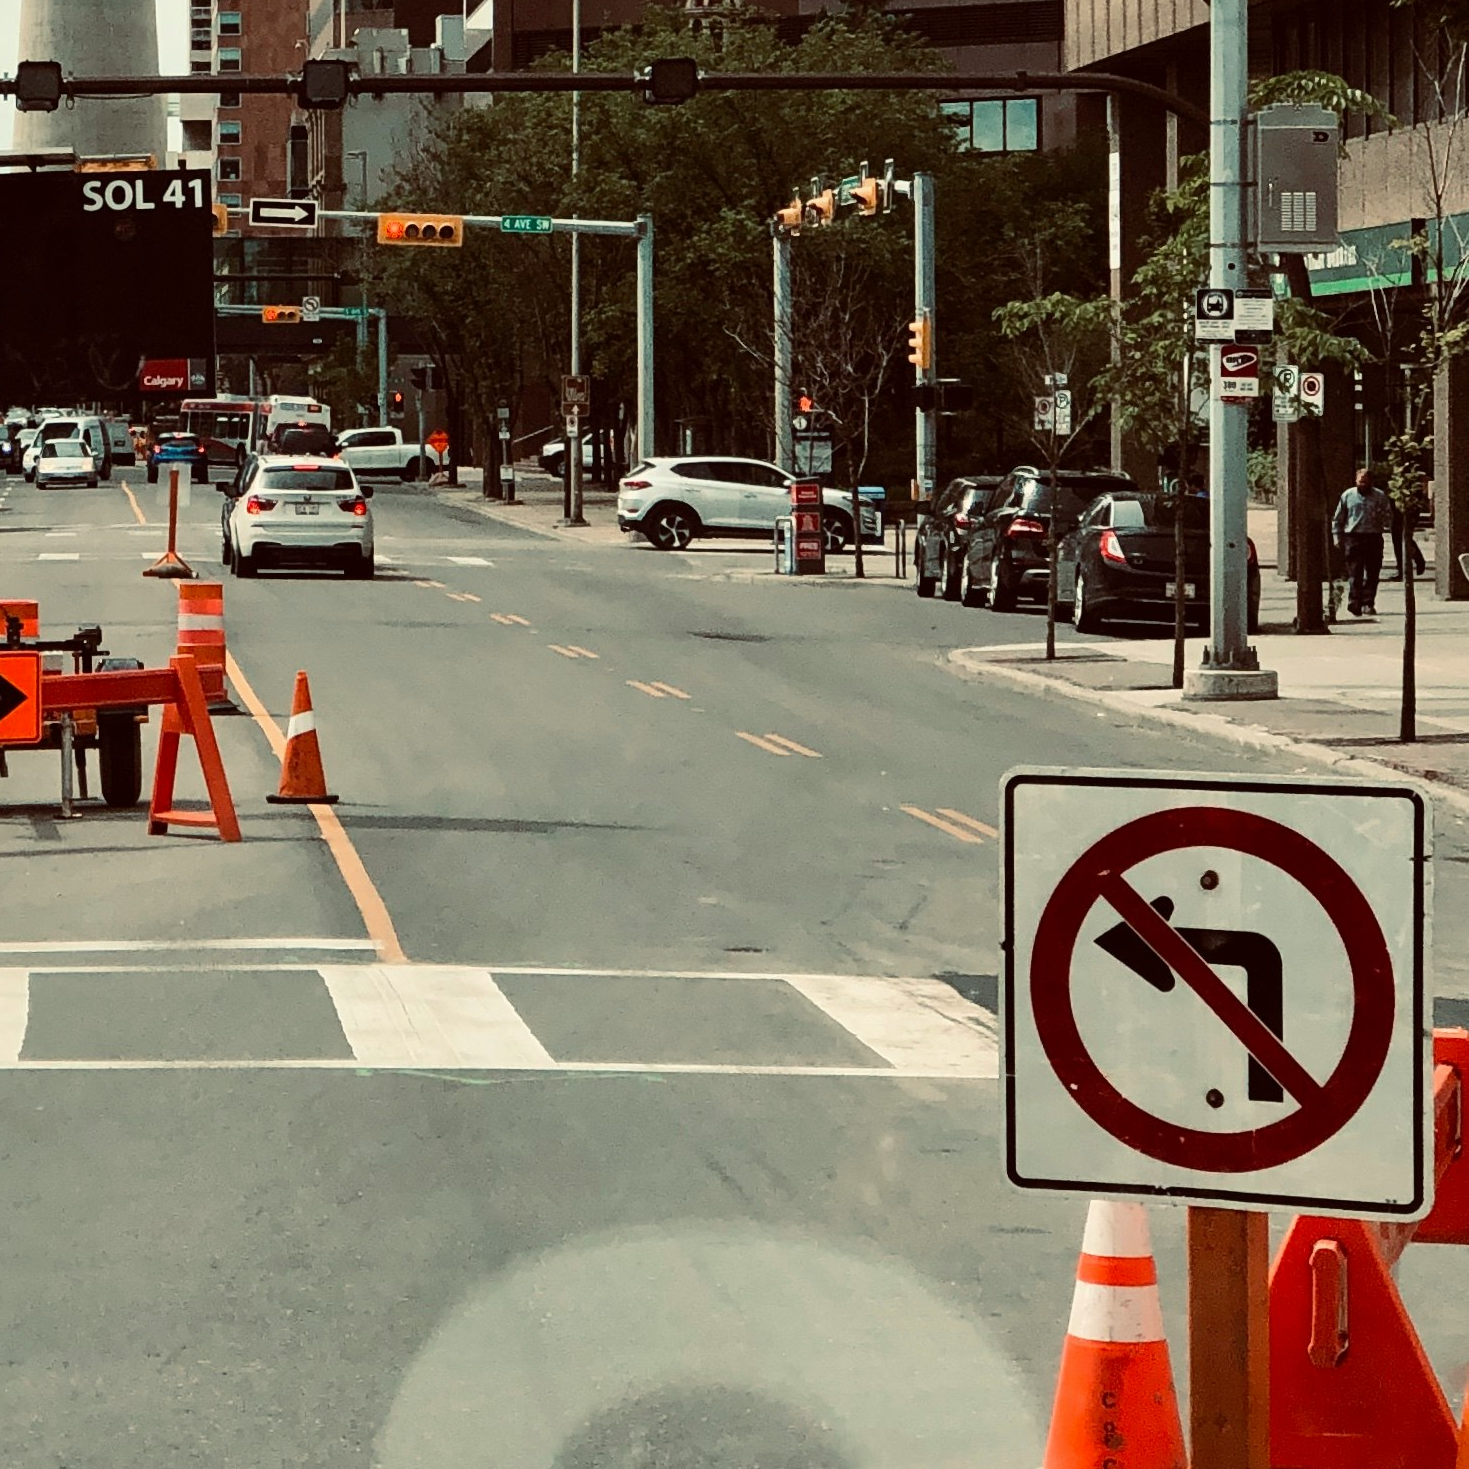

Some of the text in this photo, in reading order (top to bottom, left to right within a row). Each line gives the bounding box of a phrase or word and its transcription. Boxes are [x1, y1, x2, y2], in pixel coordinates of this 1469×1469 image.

[82, 178, 203, 212] SOL 41
[504, 218, 550, 230] 4 AVE SW
[143, 375, 185, 389] Calgary
